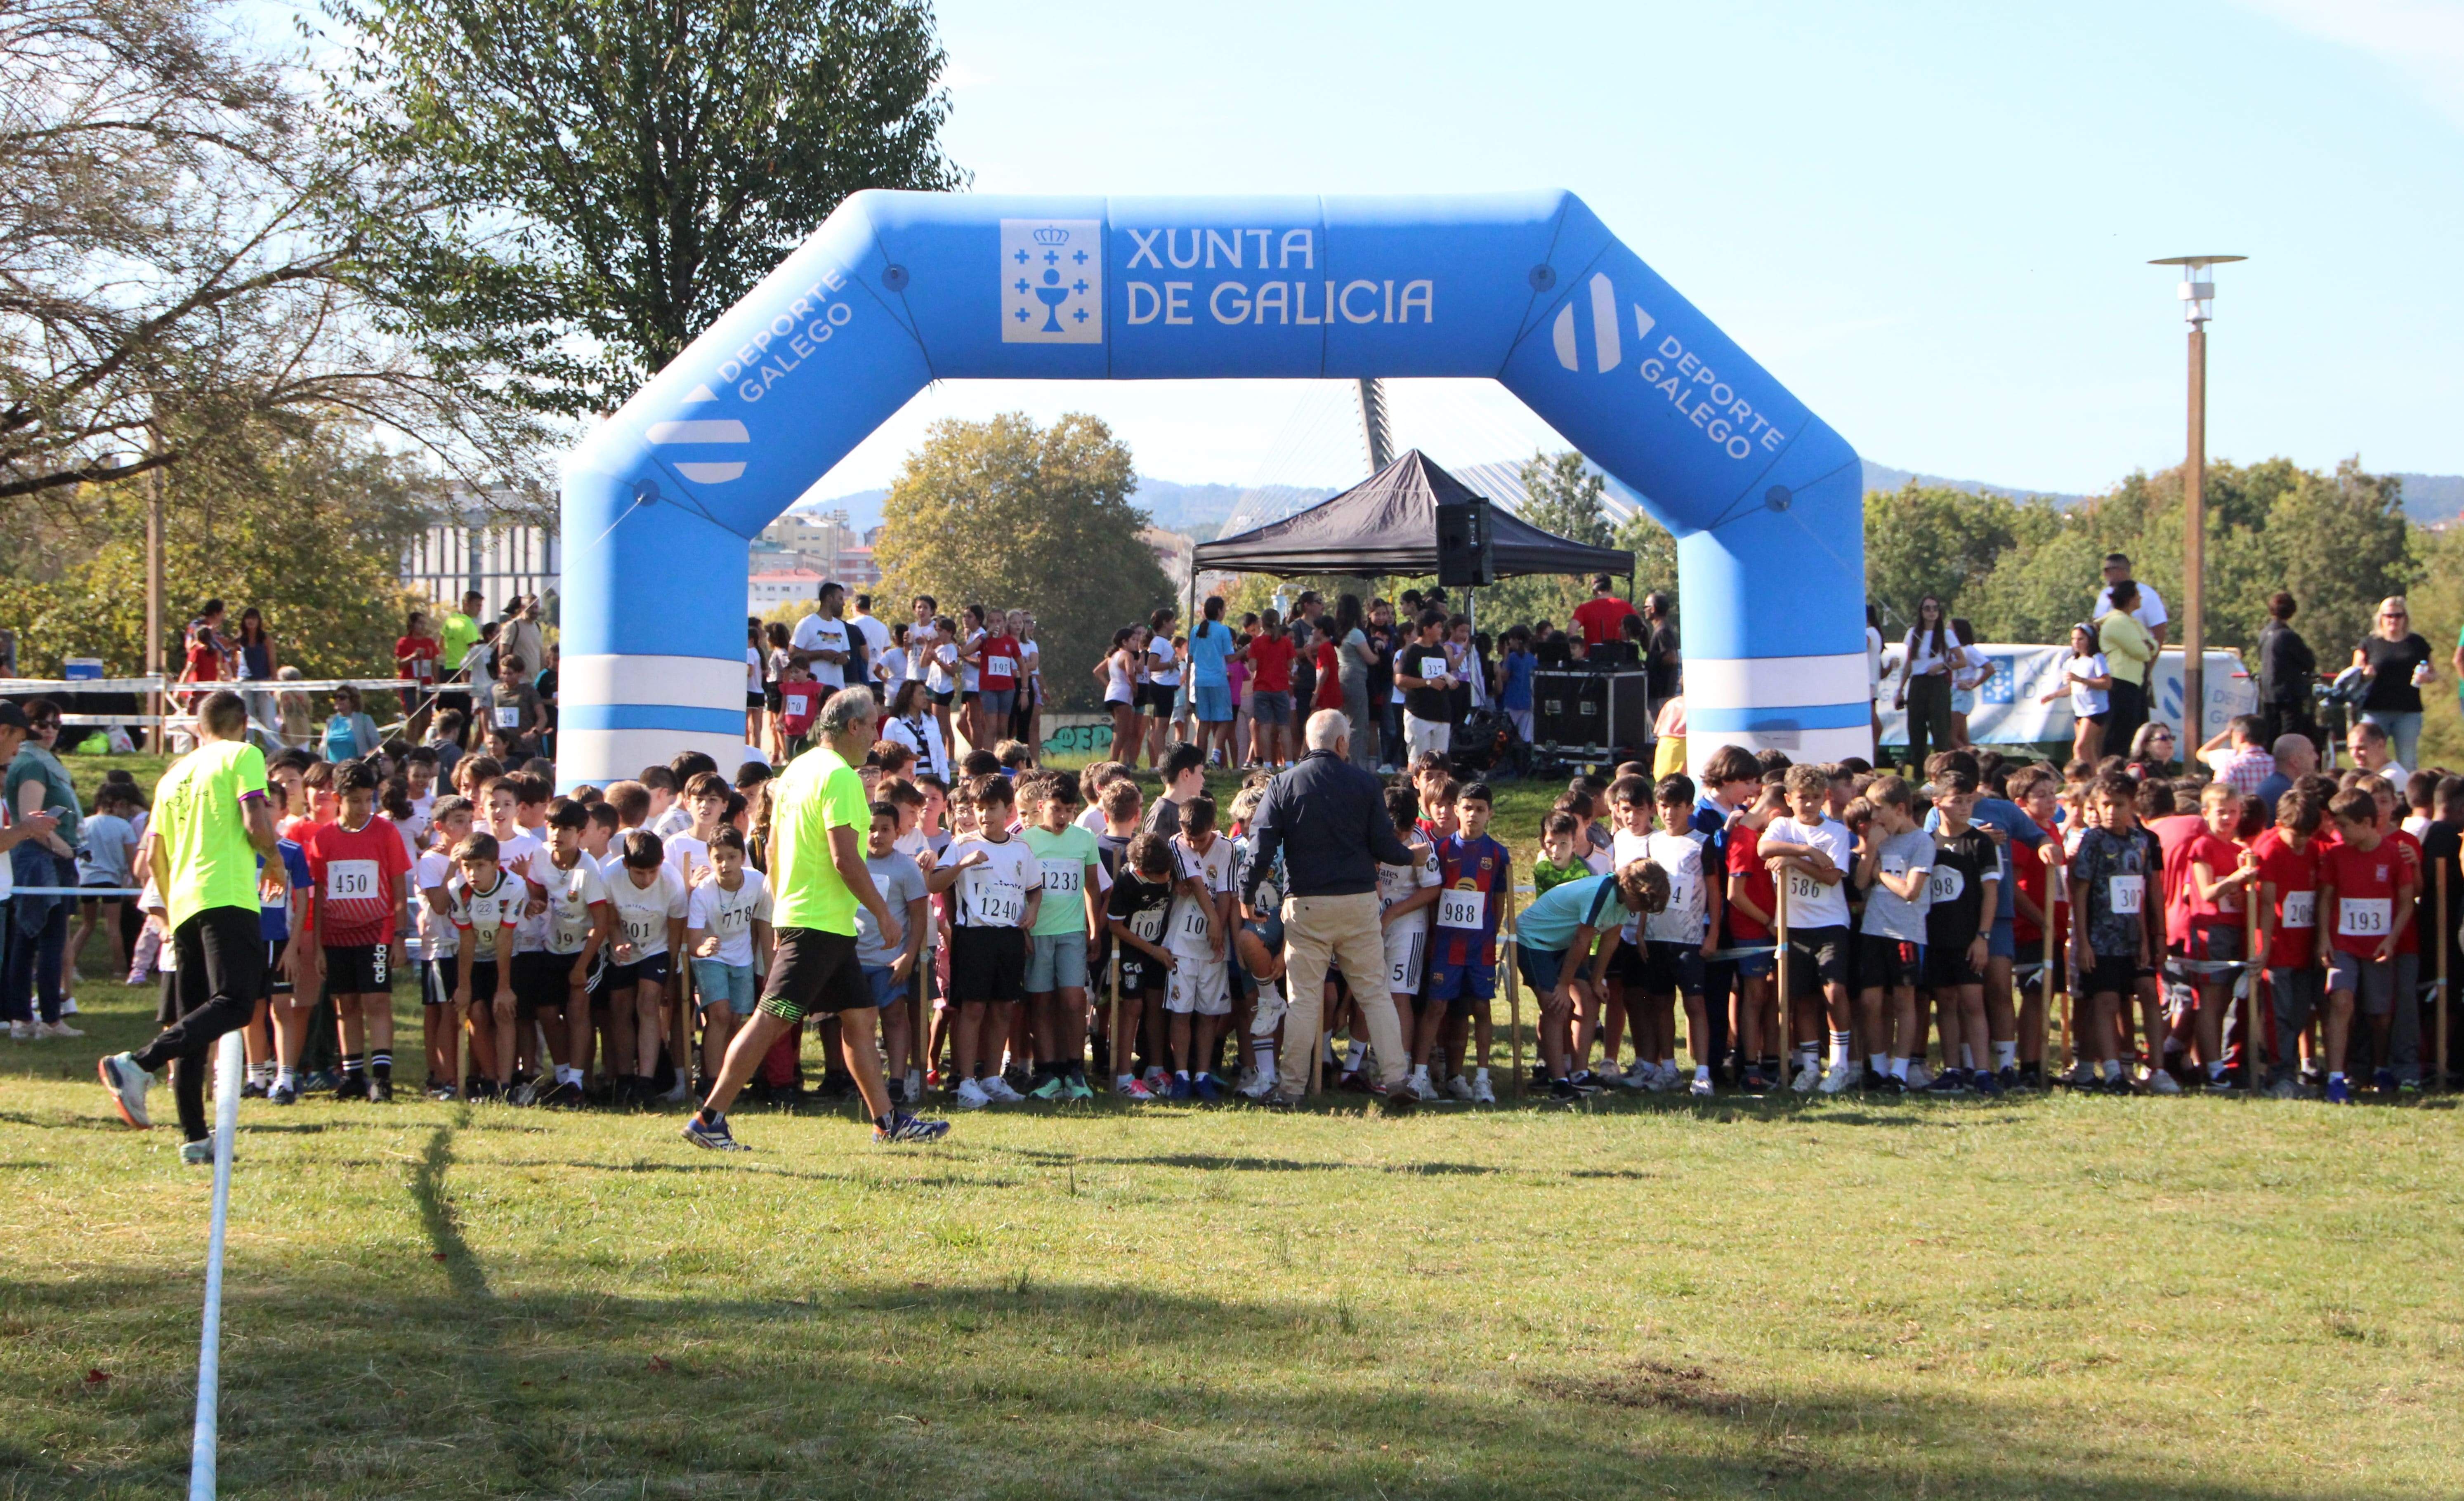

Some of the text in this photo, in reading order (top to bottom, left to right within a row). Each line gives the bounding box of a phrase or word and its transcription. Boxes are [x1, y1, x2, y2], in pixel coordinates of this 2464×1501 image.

[1126, 229, 1313, 270] XUNTA
[1127, 279, 1433, 325] DE GALICIA
[717, 268, 847, 384] DEPORTE
[739, 302, 852, 402] GALEGO
[1658, 335, 1785, 452] DEPORTE
[1640, 358, 1751, 459] GALEGO
[1428, 664, 1442, 675] 327
[335, 874, 367, 893] 450
[1041, 872, 1078, 891] 1233
[1791, 877, 1819, 898] 586
[1935, 877, 1953, 896] 98
[479, 904, 490, 912] 22
[722, 906, 751, 928] 778
[980, 897, 1017, 921] 1240
[1445, 903, 1475, 922] 988
[1185, 914, 1208, 934] 10
[2349, 912, 2381, 930] 193
[373, 943, 387, 984] adida
[1392, 964, 1404, 982] 5
